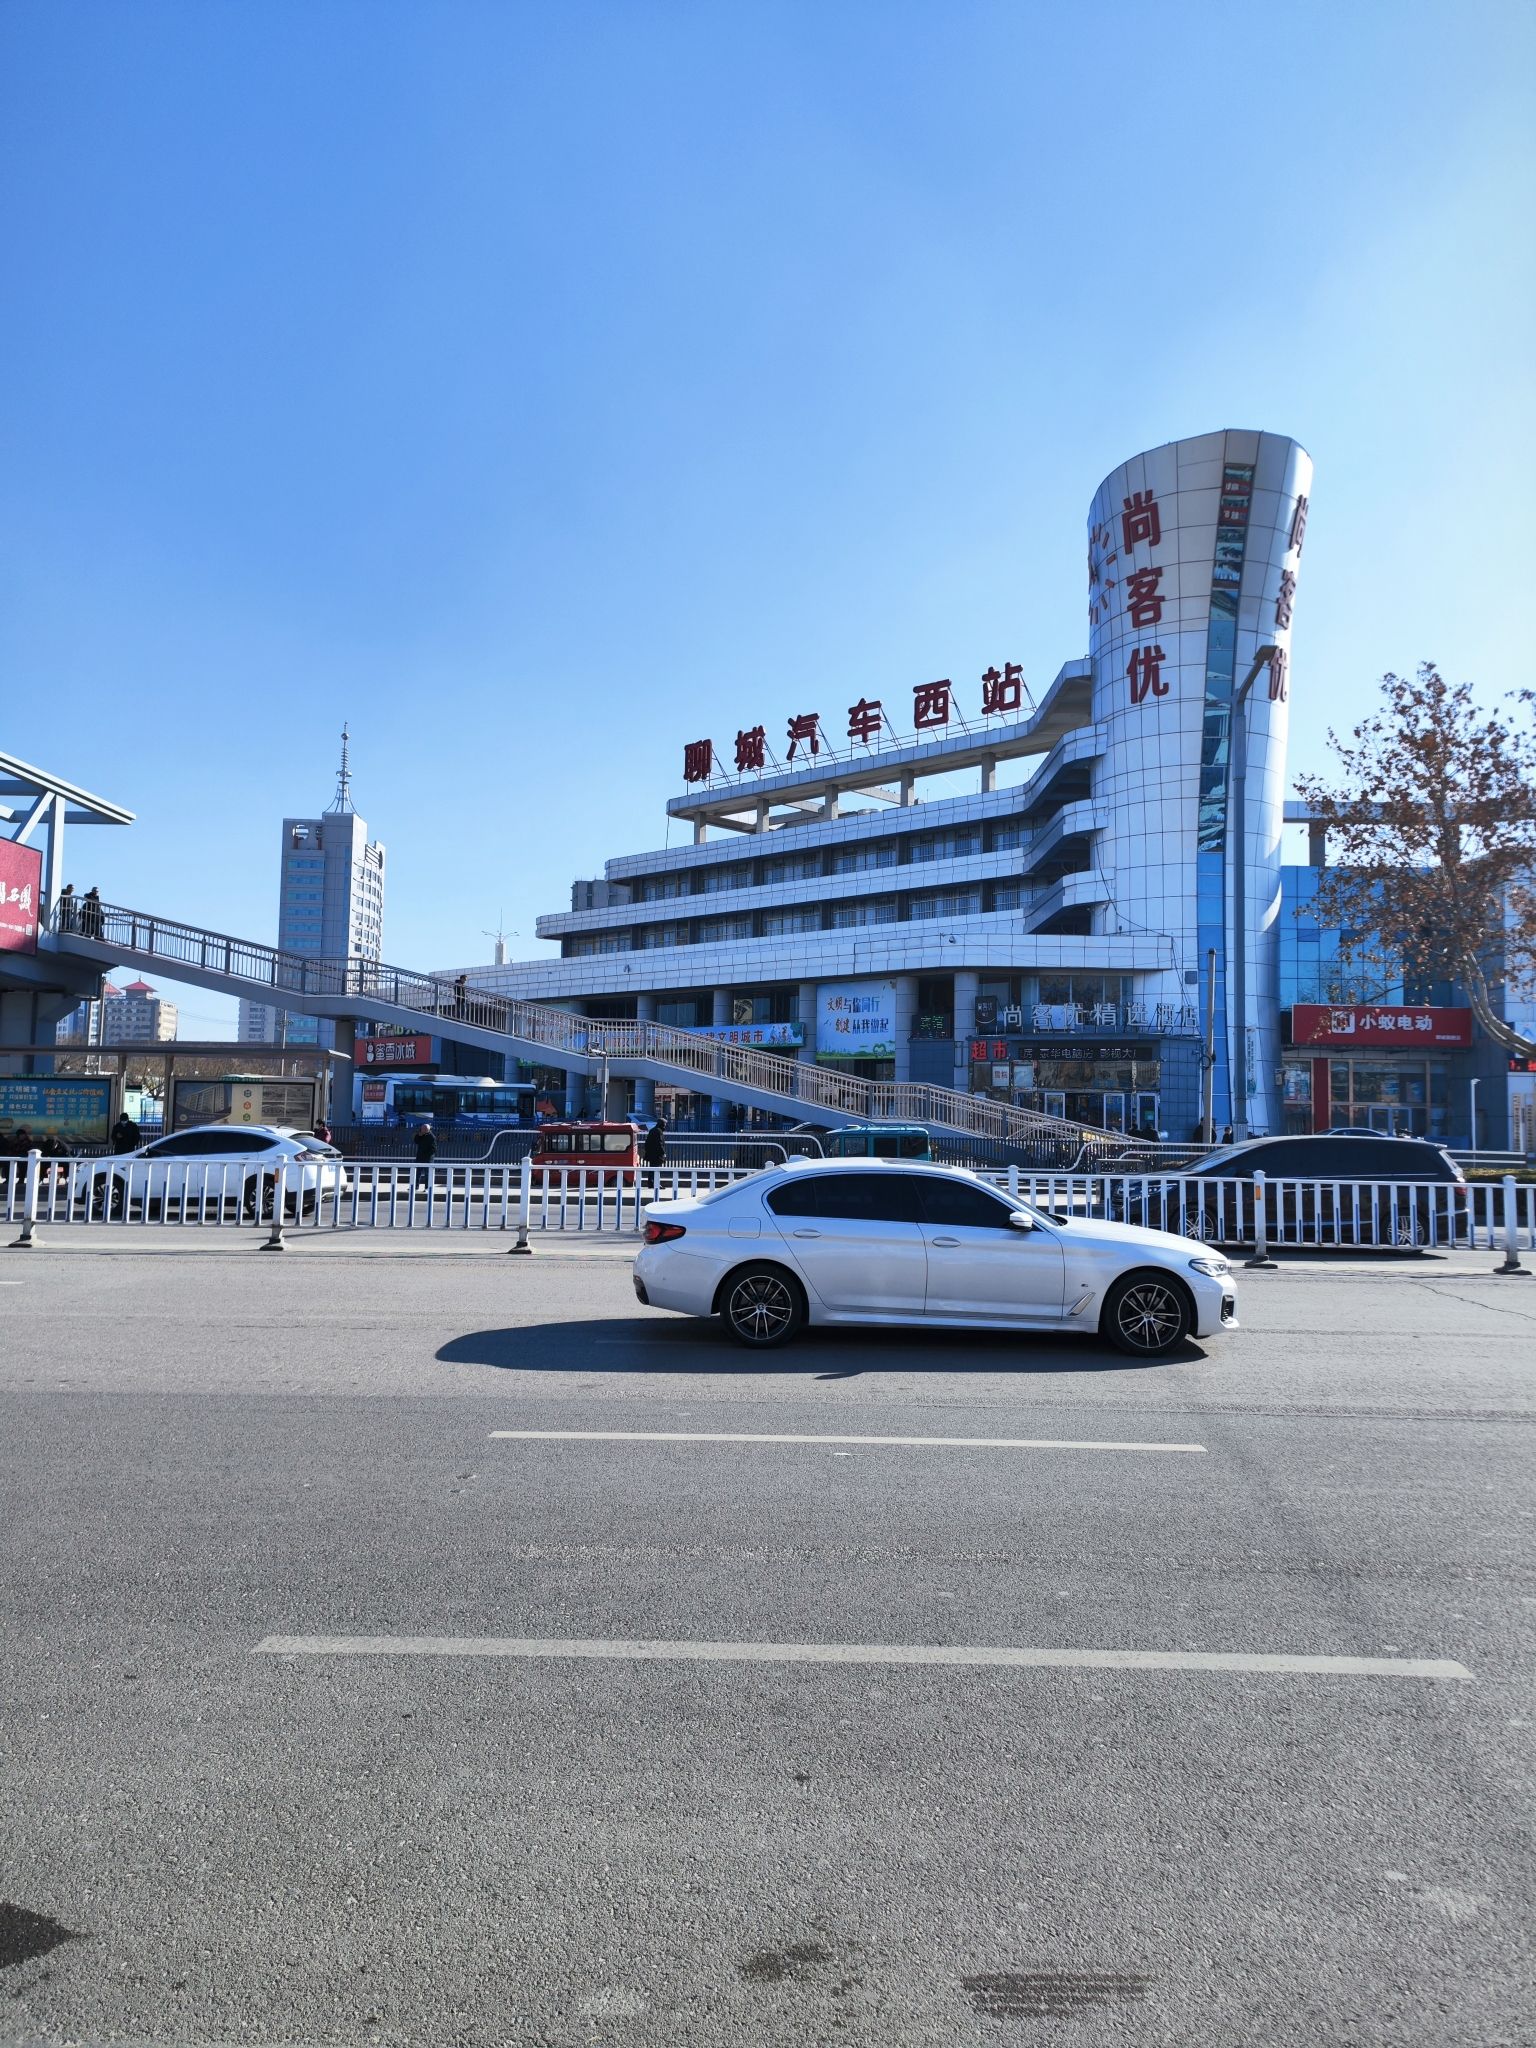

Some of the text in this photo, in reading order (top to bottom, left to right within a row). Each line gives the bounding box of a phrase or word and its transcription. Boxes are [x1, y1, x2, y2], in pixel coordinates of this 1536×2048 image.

[1121, 489, 1169, 704] 尚客优
[684, 661, 1023, 783] 聊城汽车西站
[827, 996, 880, 1013] 文明与你同行
[1003, 1001, 1198, 1030] 尚客优精选酒店
[375, 1042, 416, 1061] 蜜雪冰城
[971, 1040, 1008, 1060] 超市
